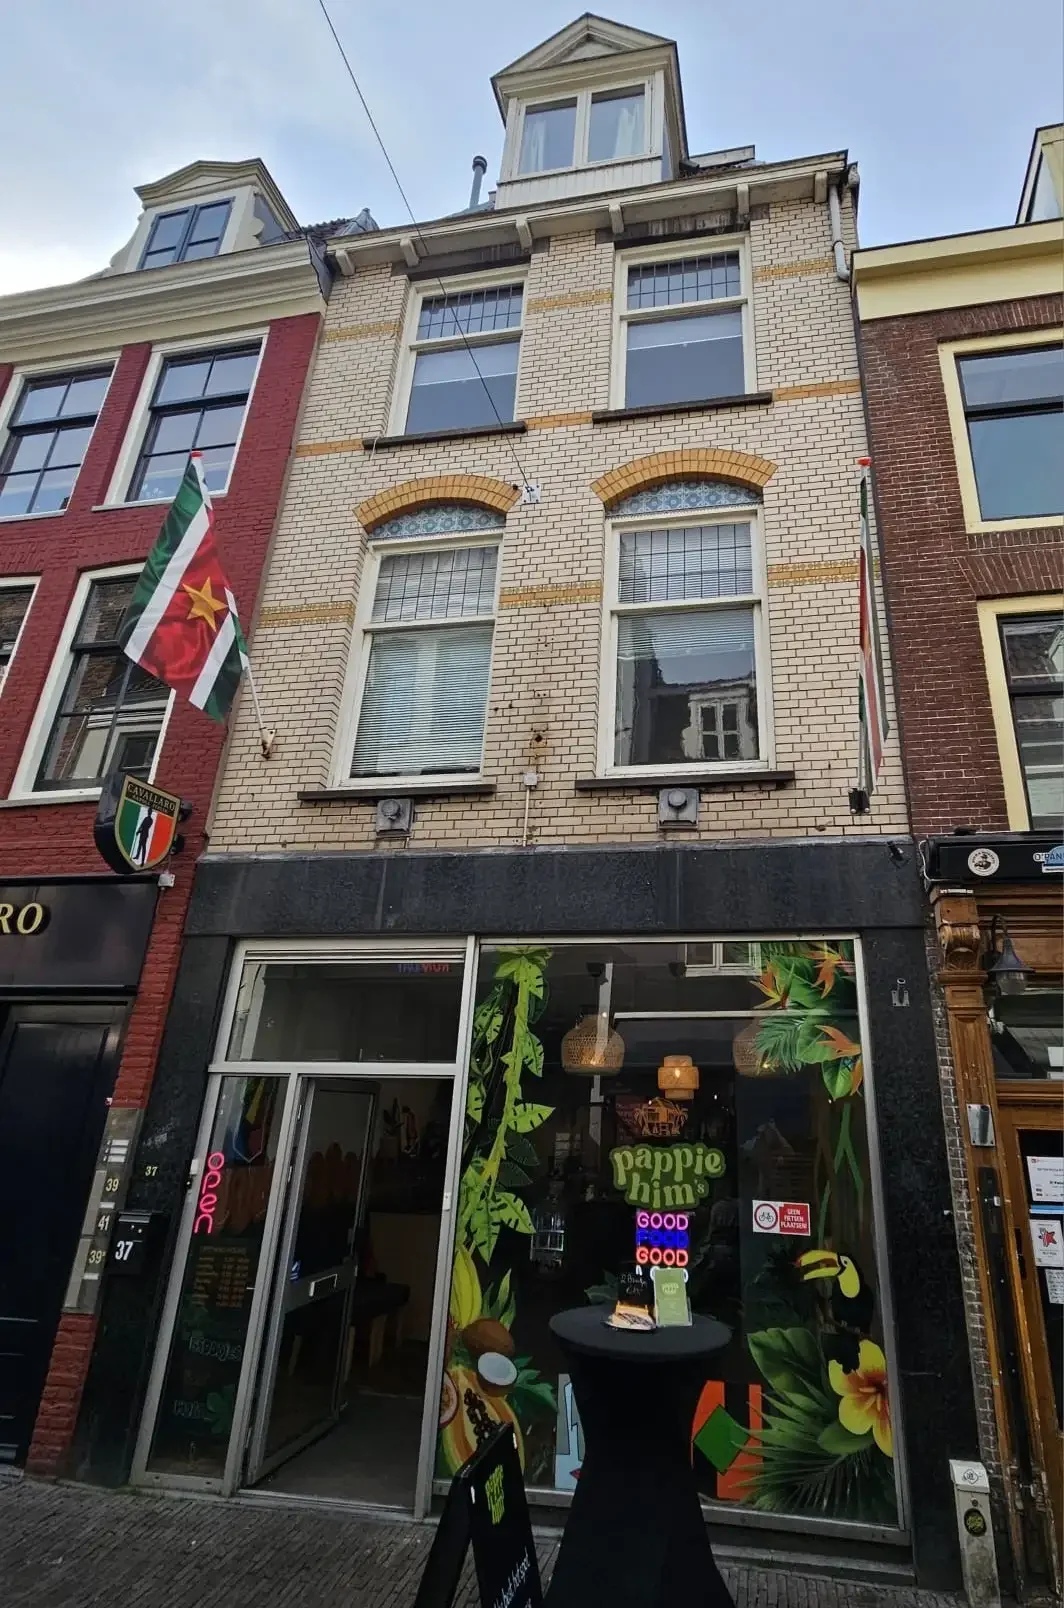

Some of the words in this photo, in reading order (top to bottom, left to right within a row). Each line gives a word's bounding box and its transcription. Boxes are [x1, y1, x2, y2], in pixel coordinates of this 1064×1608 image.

[127, 783, 175, 811] CAVALLARO
[1034, 853, 1064, 862] O'PAN
[145, 1165, 158, 1177] 37
[613, 1147, 721, 1185] pappie
[105, 1177, 119, 1192] 39
[193, 1151, 225, 1234] open
[629, 1172, 706, 1209] him's
[97, 1214, 111, 1231] 41
[636, 1211, 689, 1229] GOOD
[636, 1230, 689, 1248] FOOD
[115, 1240, 133, 1261] 37
[636, 1248, 689, 1267] GOOD
